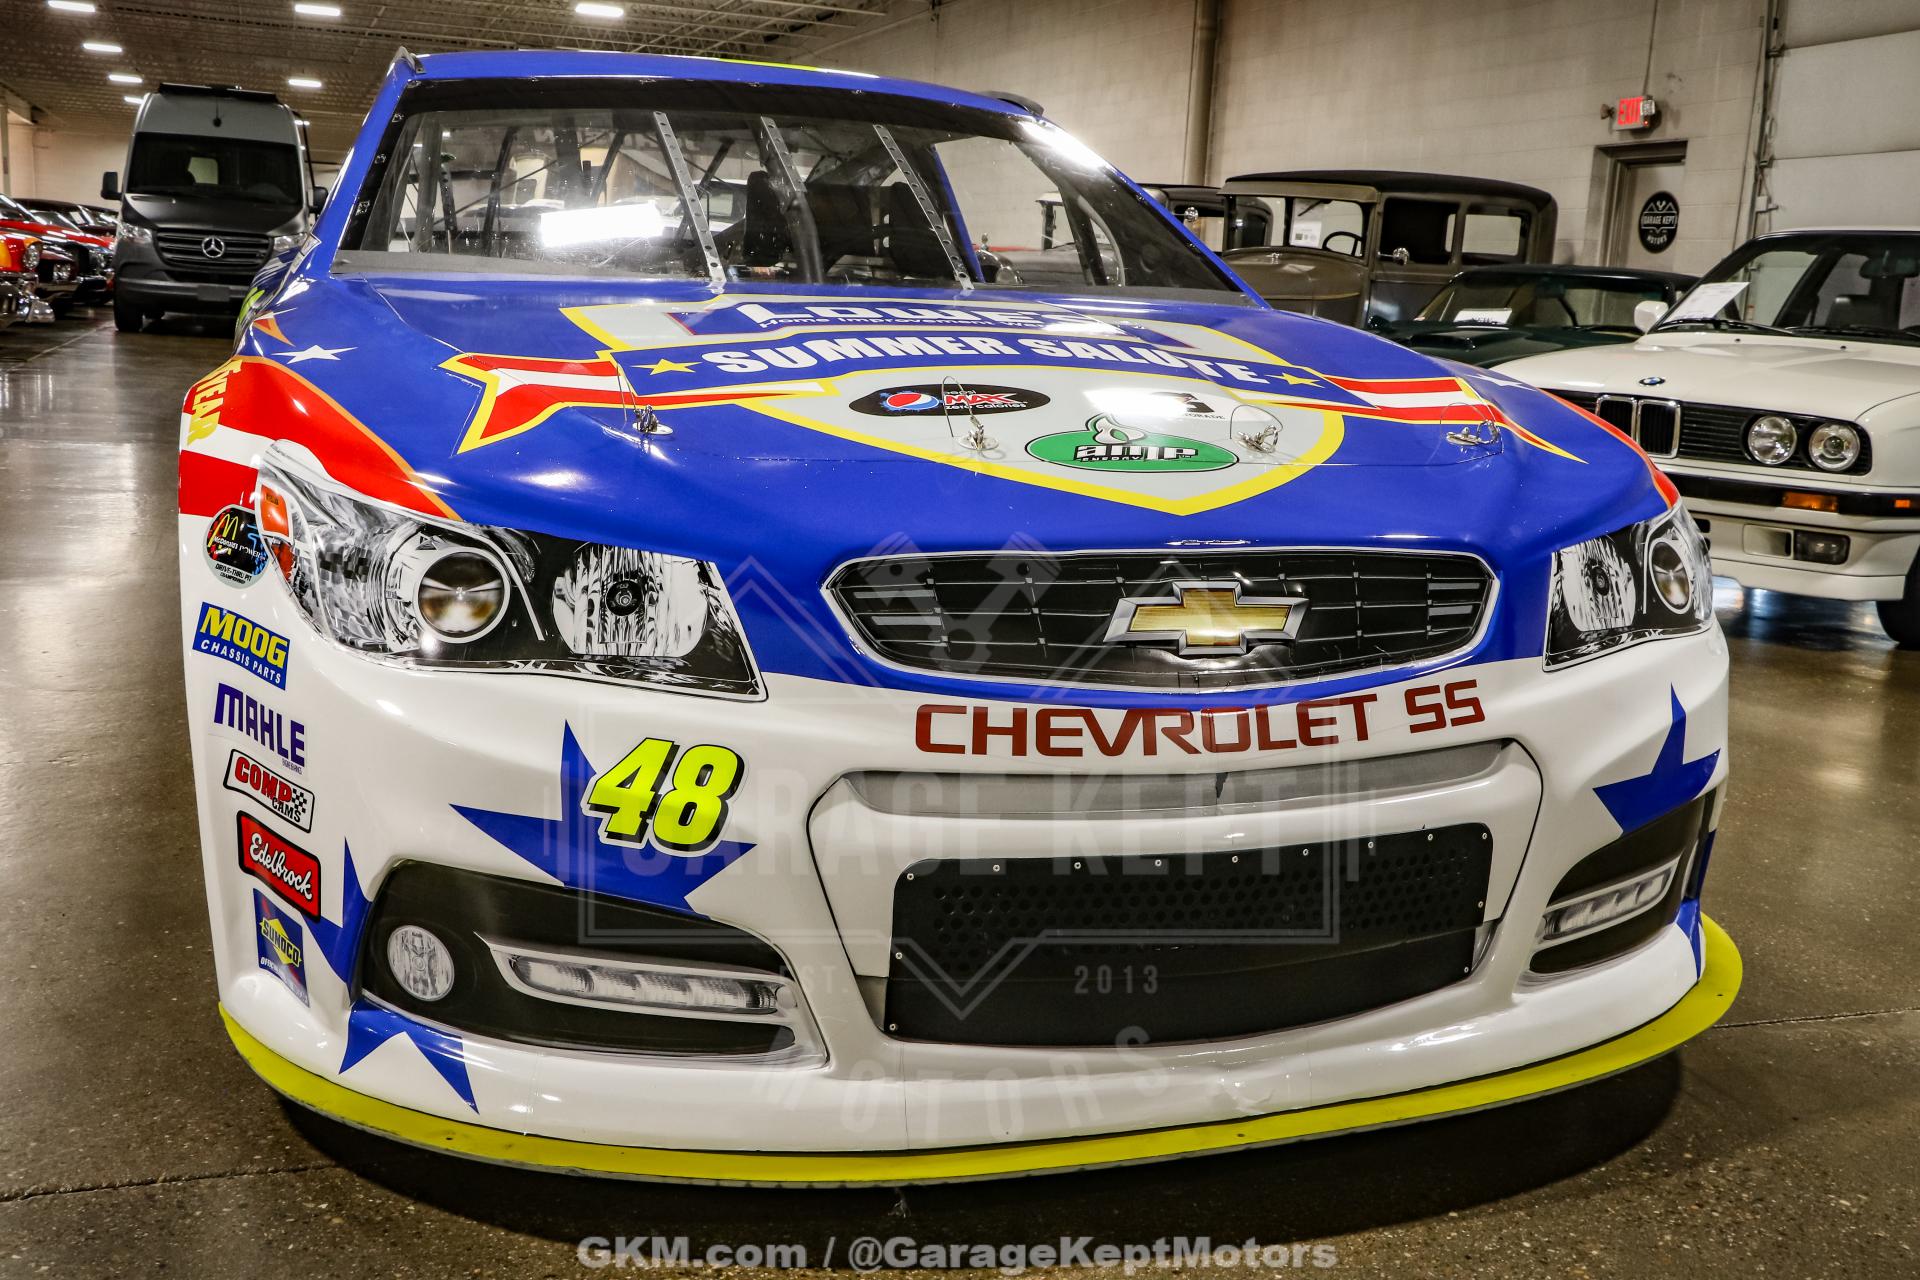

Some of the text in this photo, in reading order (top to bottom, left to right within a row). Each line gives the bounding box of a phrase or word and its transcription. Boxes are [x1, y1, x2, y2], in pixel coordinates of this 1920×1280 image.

[1617, 96, 1643, 125] EXIT
[1643, 215, 1676, 225] GARAGE KEPT
[760, 317, 829, 329] Home
[701, 336, 1270, 384] SUMMER SALUTE
[943, 392, 1017, 406] MAX
[200, 606, 288, 669] MOOG
[200, 638, 282, 685] CHASSIS PARTS
[213, 682, 305, 768] MAHLE
[914, 679, 1486, 758] CHEVROLET SS
[234, 756, 293, 803] COMP
[587, 737, 746, 852] 48
[271, 796, 301, 823] CAMS
[250, 832, 313, 901] Edelbrock
[261, 919, 300, 966] SUNOCO
